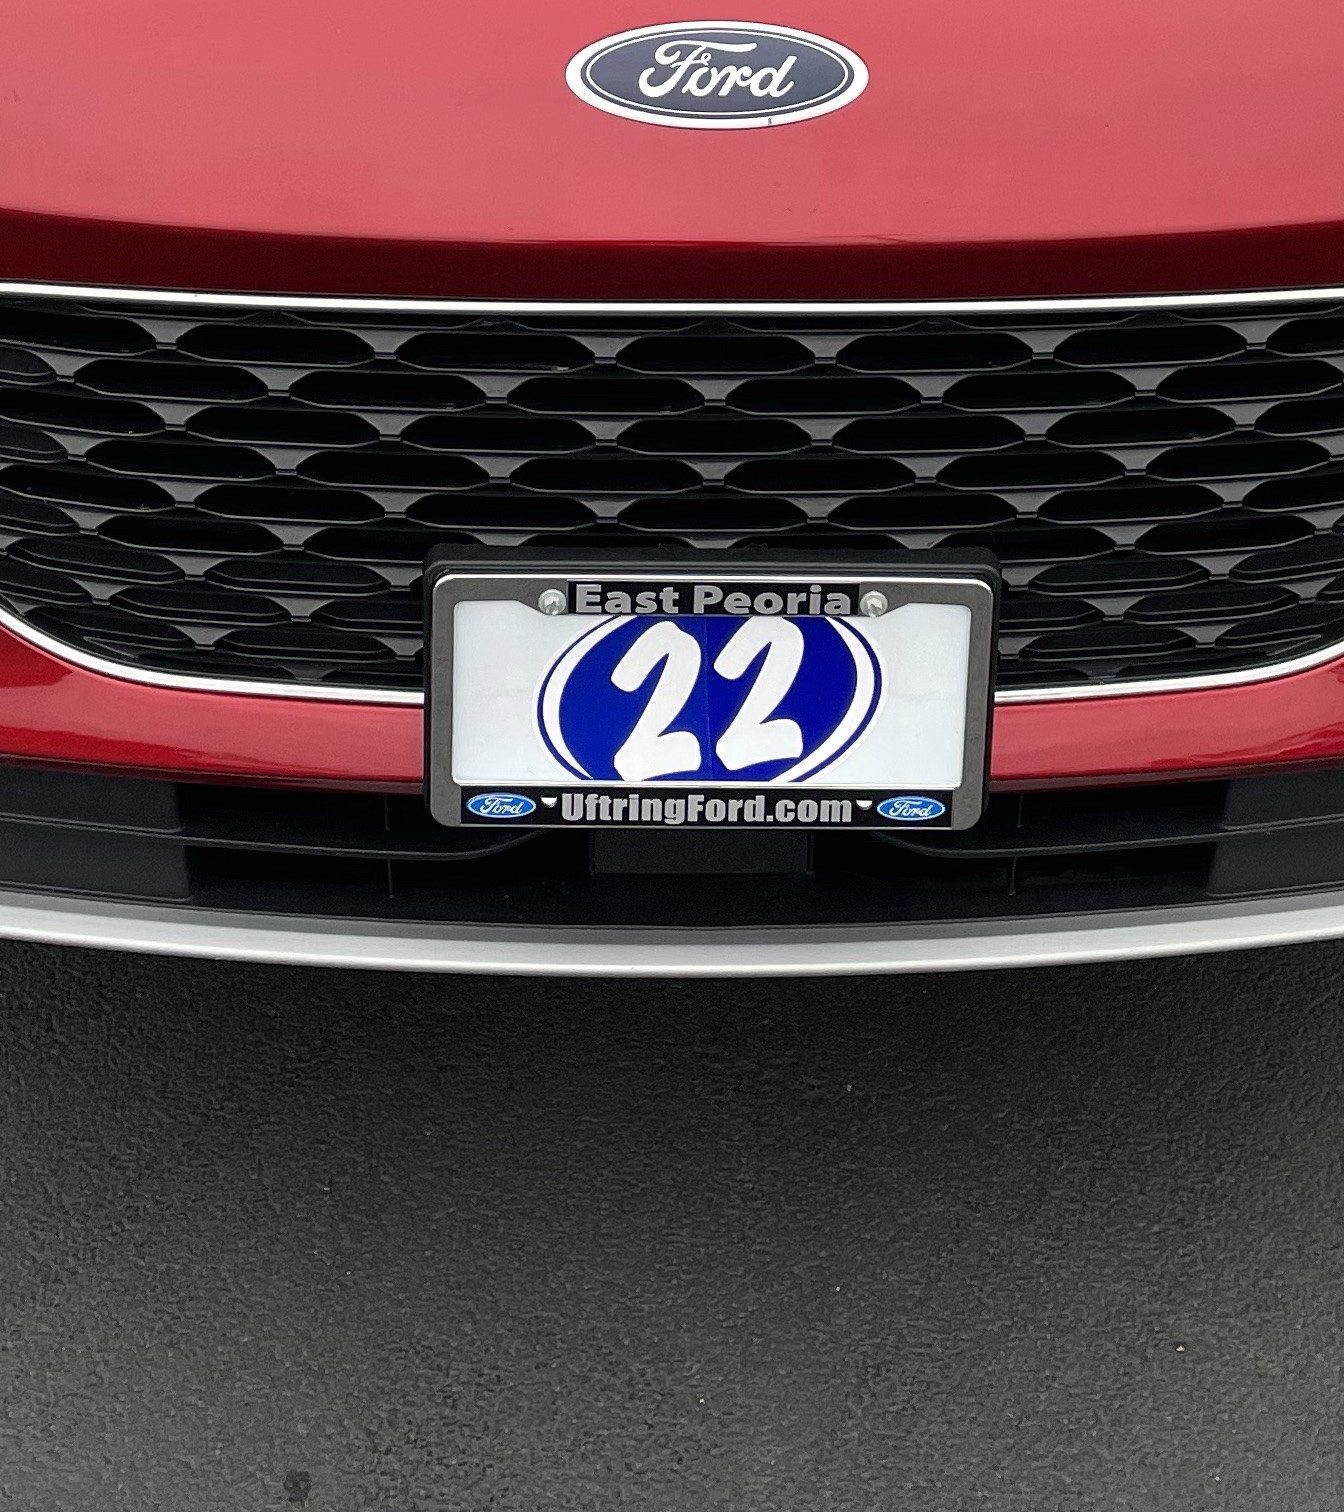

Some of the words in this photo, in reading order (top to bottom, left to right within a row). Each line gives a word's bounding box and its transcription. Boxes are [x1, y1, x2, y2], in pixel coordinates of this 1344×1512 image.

[638, 40, 798, 98] Ford
[574, 583, 680, 615] East
[692, 584, 852, 616] Peoria
[609, 616, 805, 783] 22
[479, 796, 525, 815] Ford
[561, 792, 852, 825] UftringFord.com
[888, 800, 934, 817] Ford
